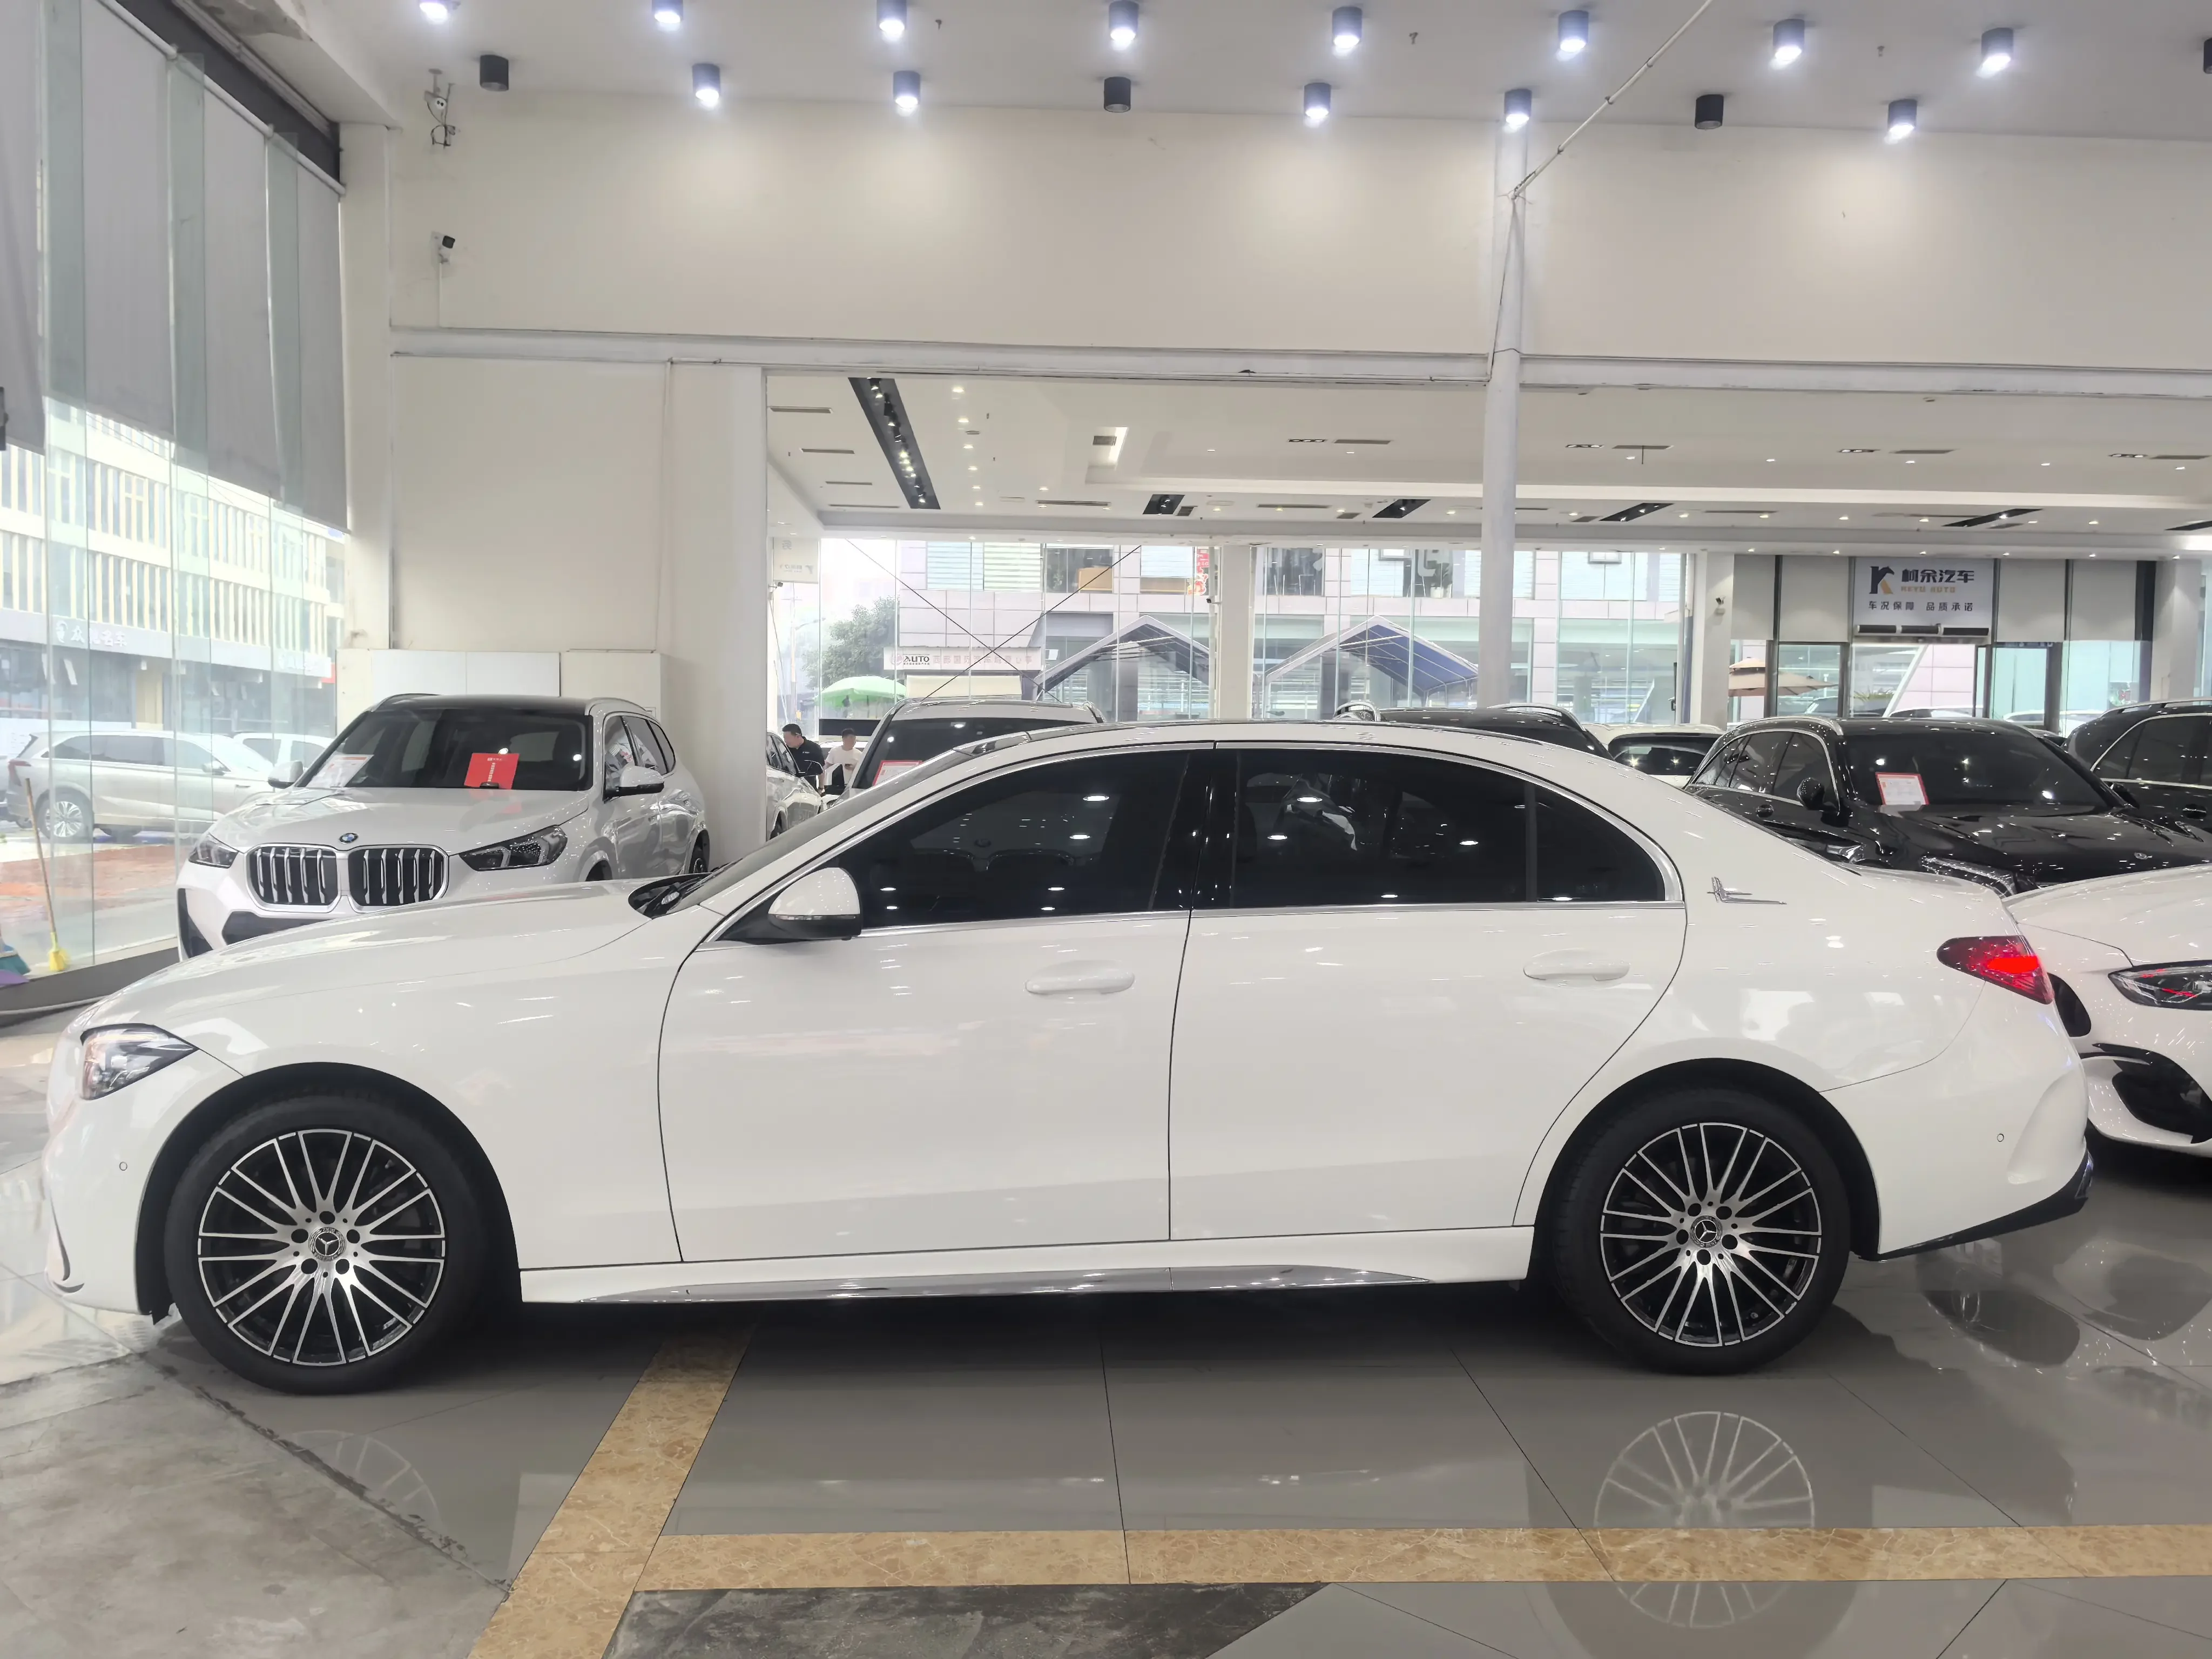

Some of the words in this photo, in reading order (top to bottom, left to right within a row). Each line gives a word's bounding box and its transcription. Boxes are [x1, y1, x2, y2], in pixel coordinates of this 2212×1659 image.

[1901, 569, 1974, 583] 柯余汽车
[1869, 601, 1914, 611] 车况保障
[1926, 602, 1973, 612] 品质承诺
